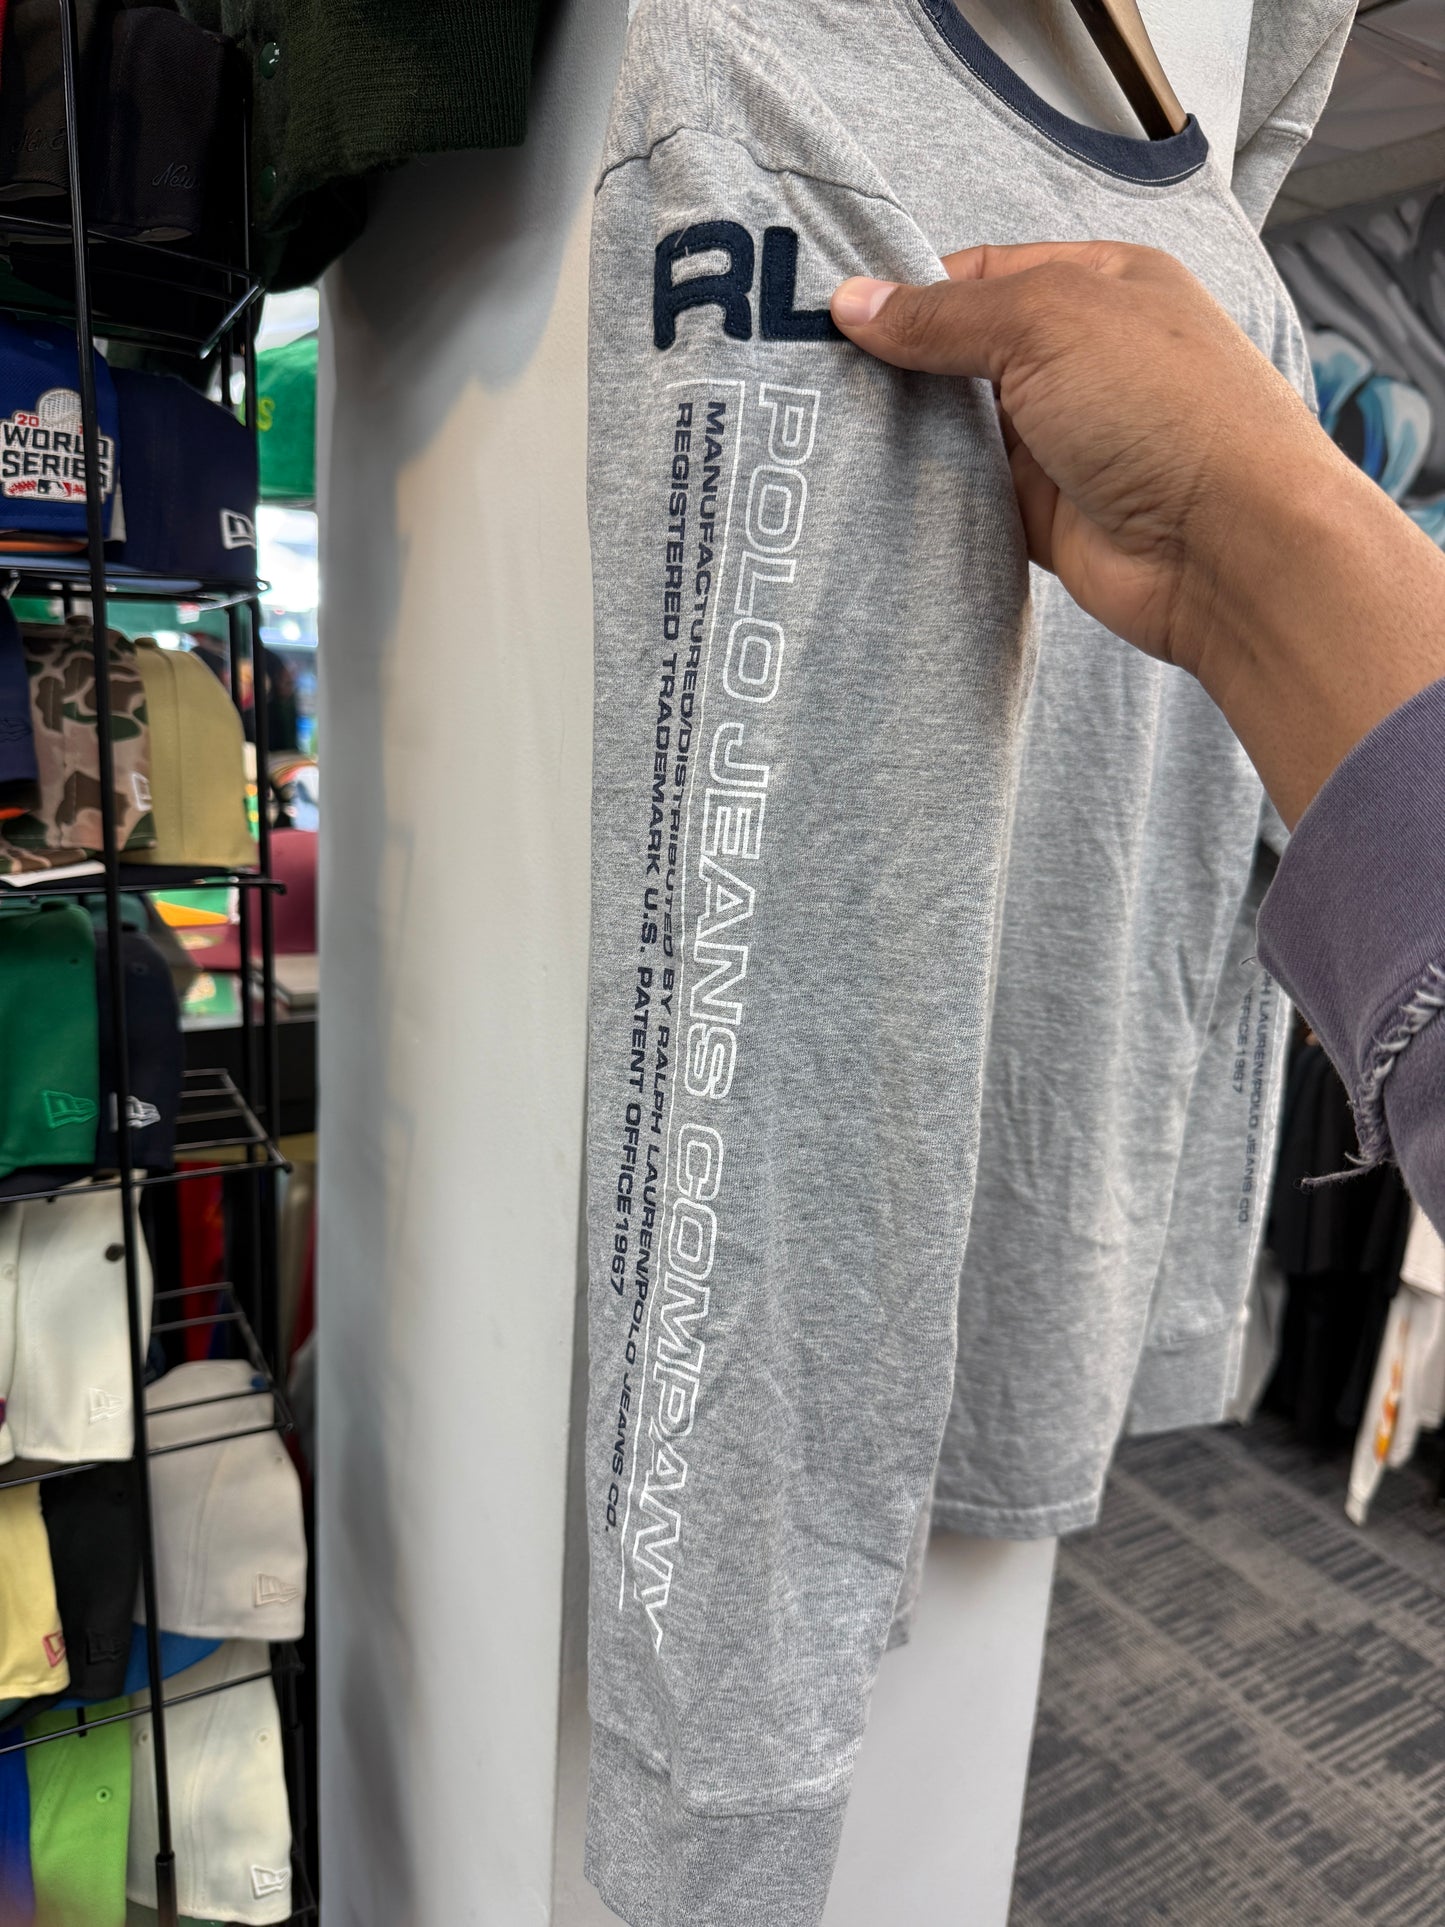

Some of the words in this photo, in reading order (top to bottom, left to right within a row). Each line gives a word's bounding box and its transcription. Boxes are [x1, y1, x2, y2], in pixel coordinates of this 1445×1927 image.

[653, 220, 850, 350] RL
[2, 449, 108, 489] SERIES
[4, 424, 109, 459] WORLD
[663, 401, 694, 641] REGISTERED
[722, 382, 821, 703] POLO
[663, 401, 727, 958] MANUFACTURED/DISTRIBUTED
[645, 653, 678, 874] TRADEMARK
[639, 888, 660, 952] U.S.
[684, 721, 769, 1100] JEANS
[629, 967, 653, 1093] PATENT
[660, 968, 675, 1016] BY
[650, 1025, 671, 1134] RALPH
[610, 1102, 643, 1296] OFFICE1967
[1242, 1134, 1258, 1193] JEANS
[625, 1144, 660, 1365] LAUREN/POLO
[611, 1372, 631, 1476] JEANS
[633, 1124, 724, 1655] COMPANY
[605, 1483, 620, 1533] CO.
